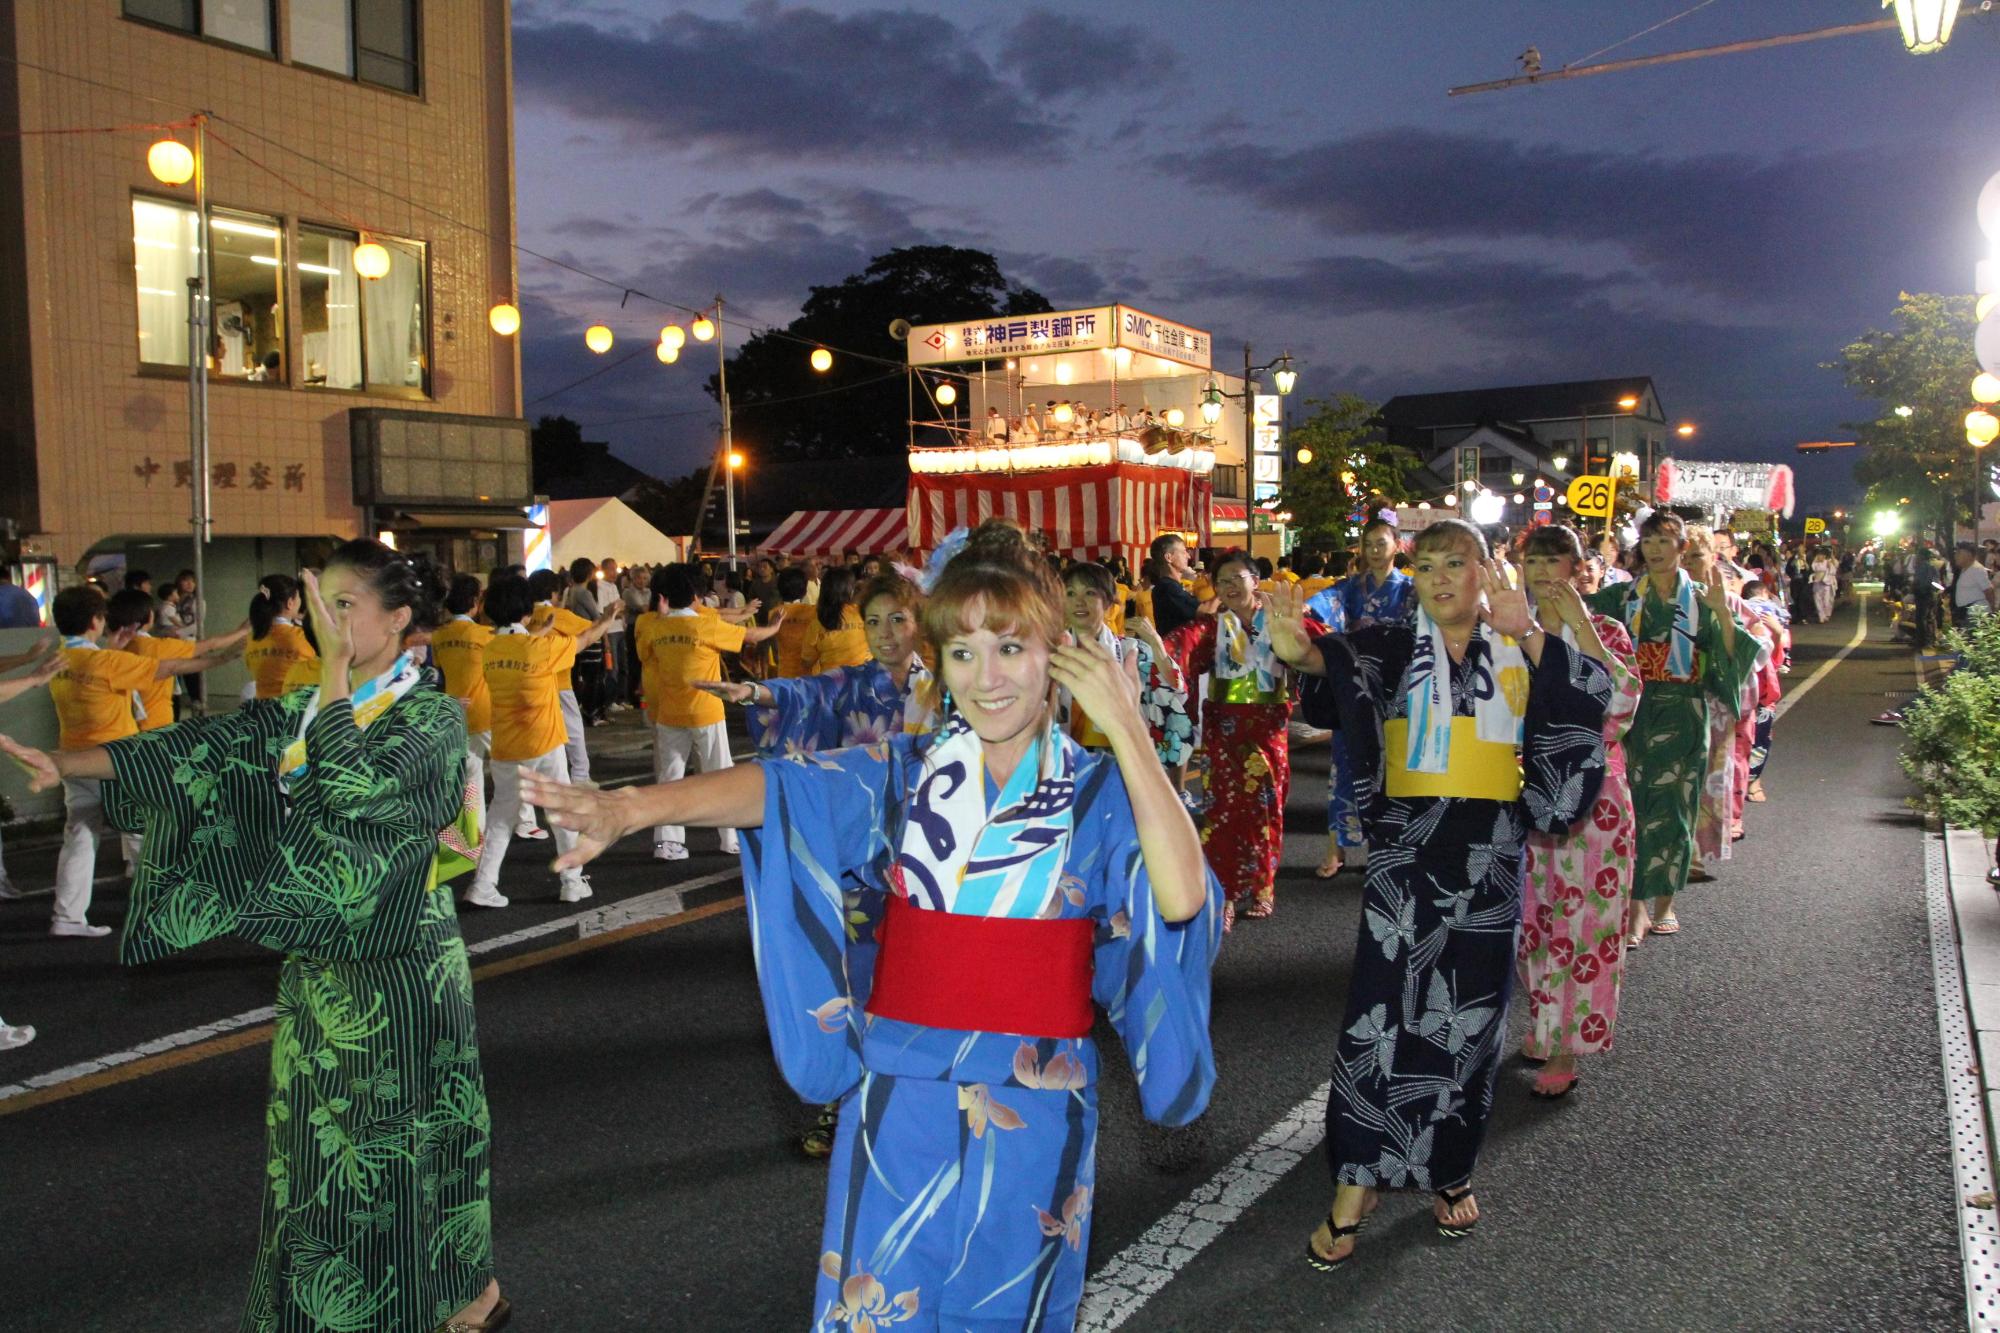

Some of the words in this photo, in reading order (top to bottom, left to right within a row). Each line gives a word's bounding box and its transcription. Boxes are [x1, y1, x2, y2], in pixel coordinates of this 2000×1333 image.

[986, 314, 1096, 344] 神戸製鋼所
[1125, 313, 1153, 338] SMIC
[1258, 398, 1276, 478] くすり
[1576, 482, 1609, 510] 26
[1807, 520, 1821, 531] 28
